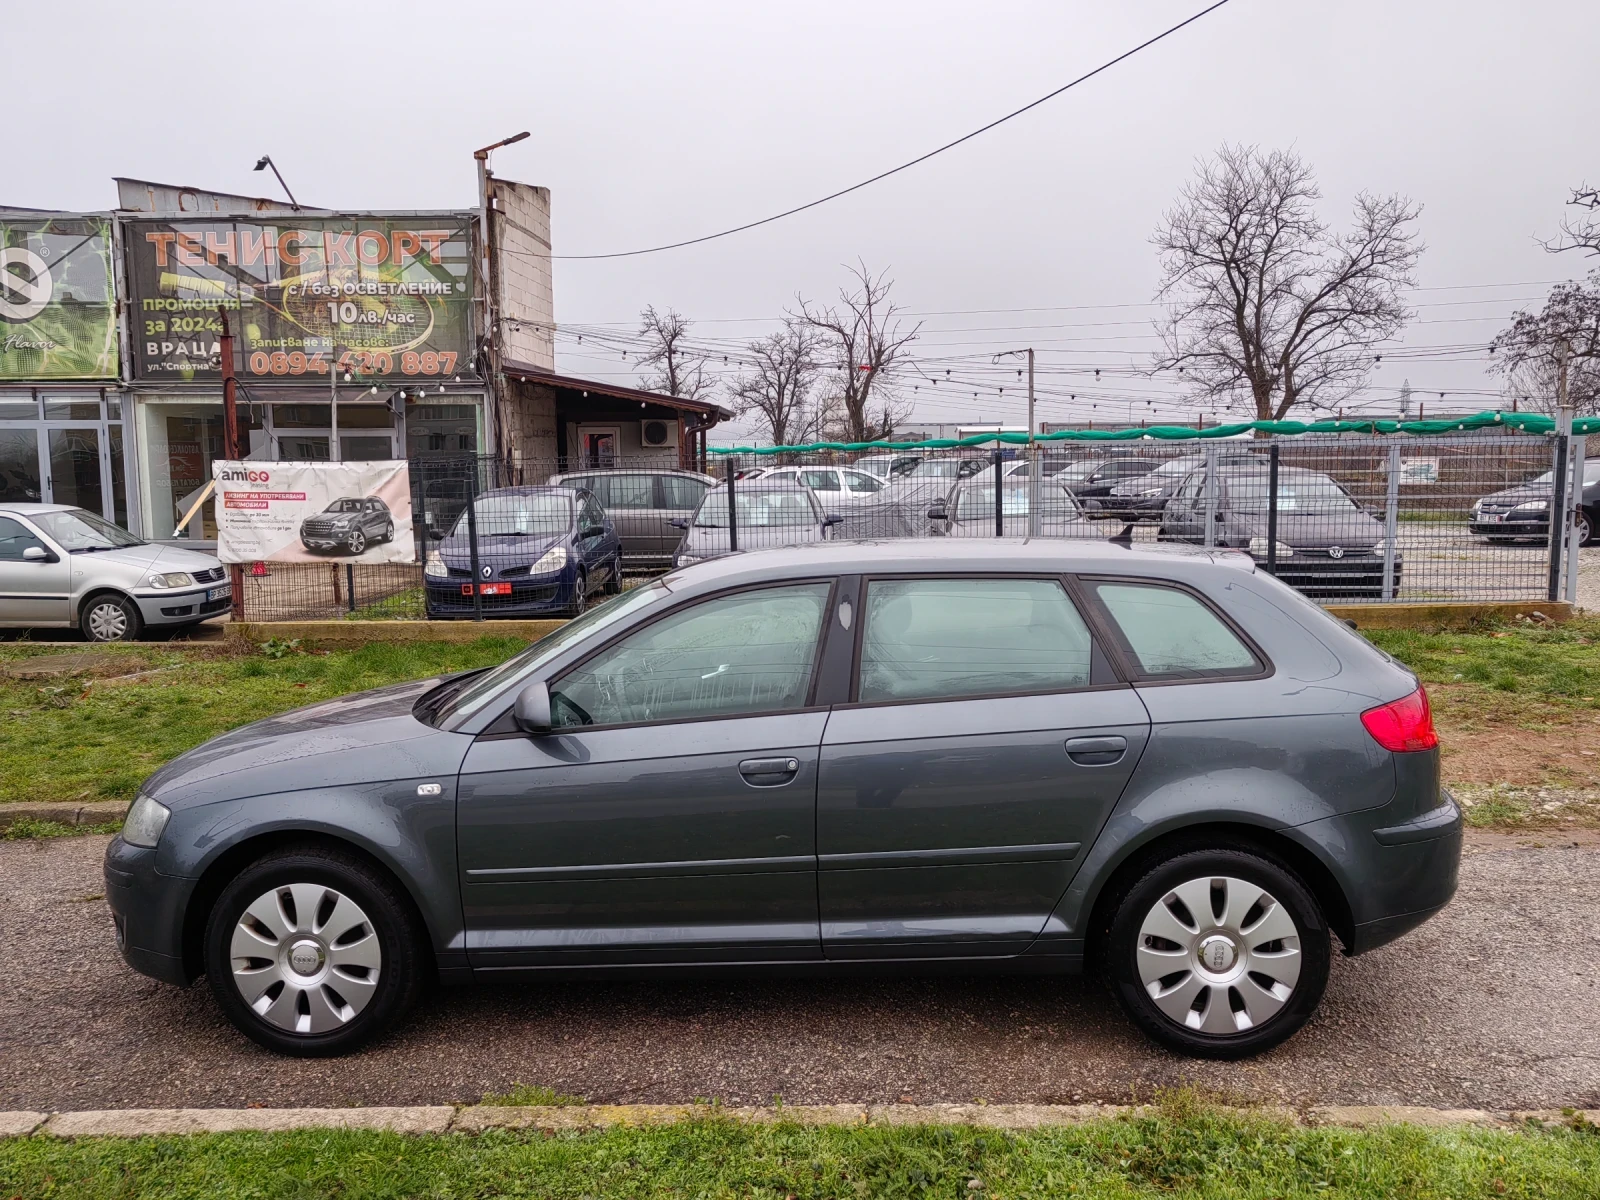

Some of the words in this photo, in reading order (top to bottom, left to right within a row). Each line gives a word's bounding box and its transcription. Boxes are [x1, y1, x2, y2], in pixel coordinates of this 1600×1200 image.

[146, 230, 308, 266] ТЕНИС
[324, 230, 450, 266] КОРТ
[312, 281, 340, 297] без
[344, 282, 452, 295] ОСВЕТЛЕНИЕ
[142, 299, 241, 312] ПРОМОЦИЯ
[145, 320, 166, 335] за
[3, 334, 57, 353] Flavor
[146, 342, 221, 357] ВРАЦА
[250, 351, 329, 375] 0894
[336, 351, 393, 375] 420
[401, 351, 458, 375] 887
